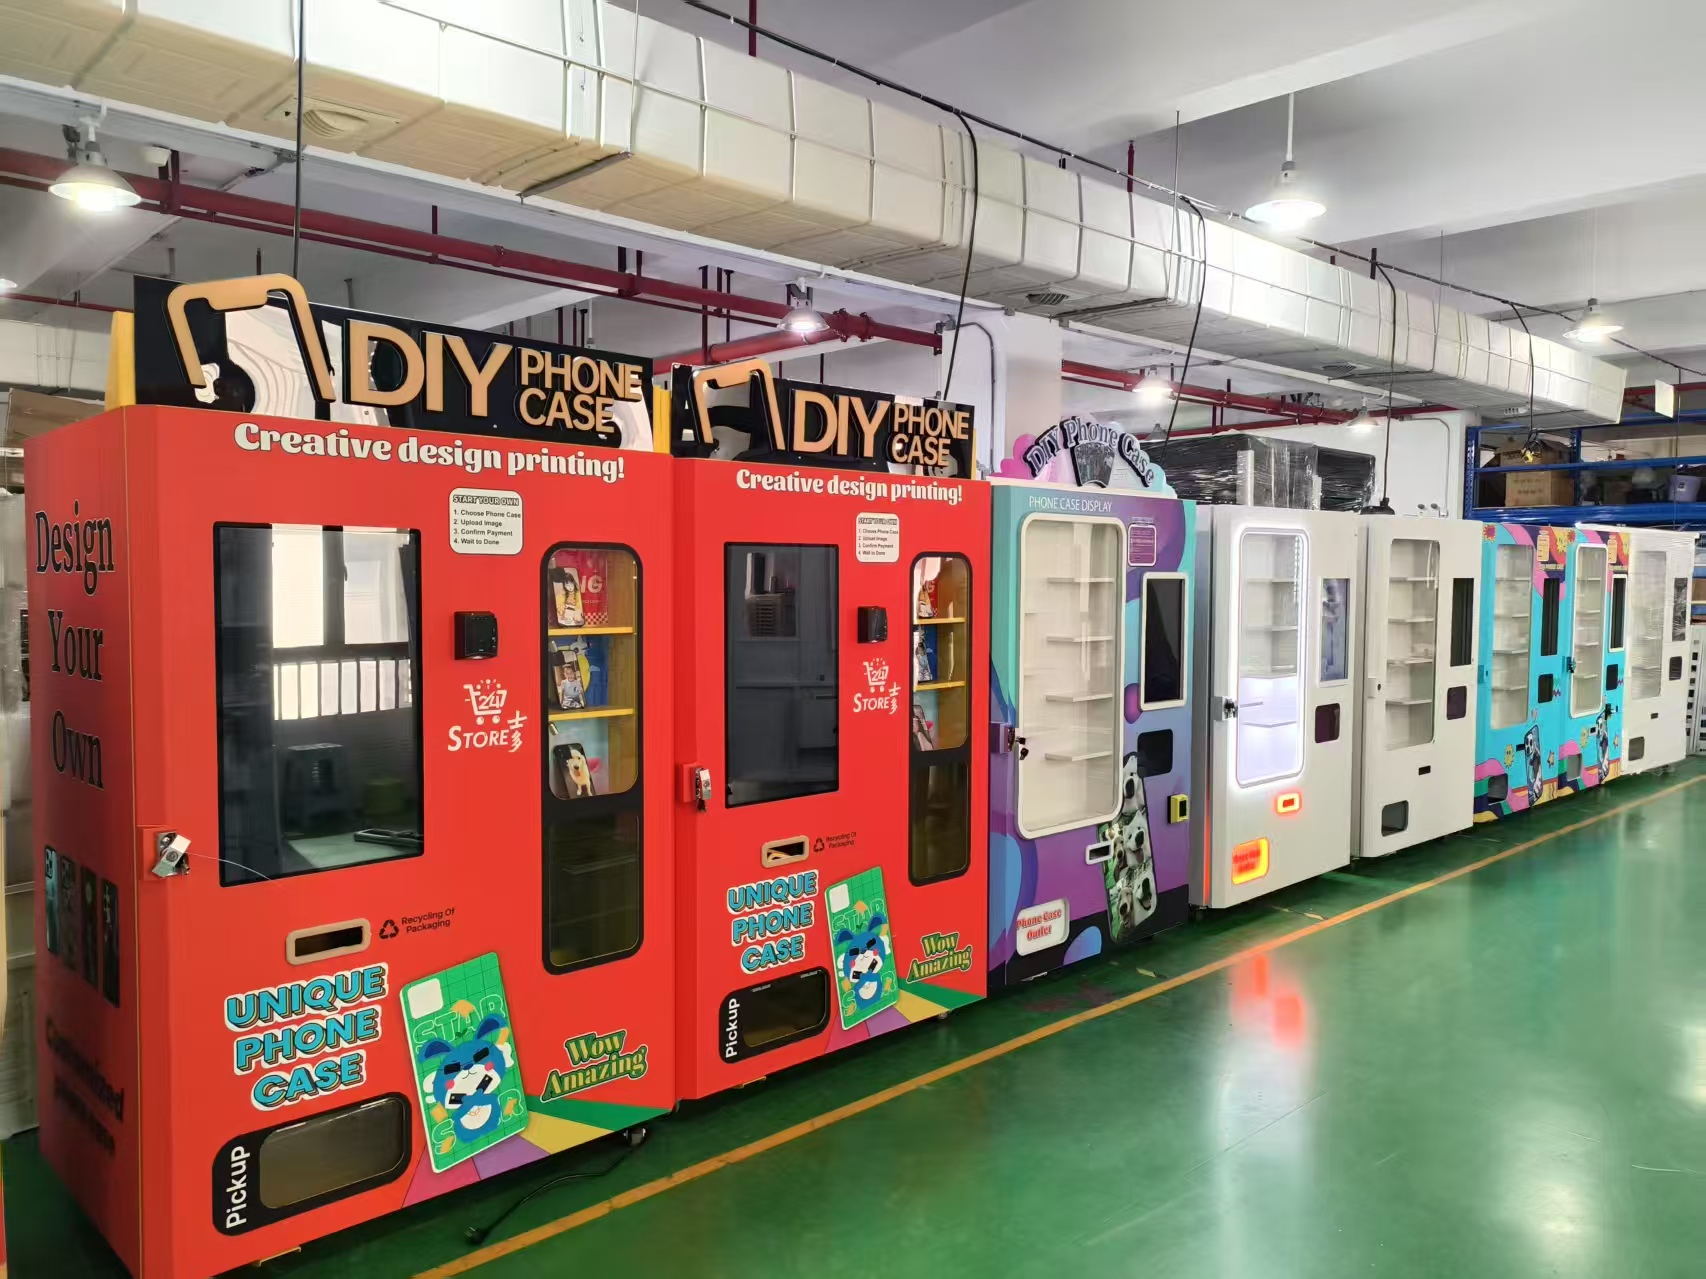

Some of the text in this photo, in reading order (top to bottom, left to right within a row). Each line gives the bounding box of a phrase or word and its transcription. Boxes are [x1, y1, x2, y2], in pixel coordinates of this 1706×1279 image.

[348, 320, 513, 417] DIY
[520, 346, 643, 402] PHONE
[518, 386, 616, 433] CASE
[793, 388, 891, 459] DIY
[893, 403, 970, 440] PHONE
[234, 422, 626, 484] Creative design printing!
[891, 433, 951, 467] CASE
[1027, 417, 1155, 484] DIY Phone Case
[453, 495, 519, 506] START YOUR OWN
[736, 468, 963, 506] Creative design printing!
[1029, 495, 1113, 513] PHONE CASE DISPLAY
[460, 509, 484, 517] Choose
[485, 510, 505, 518] Phone
[460, 519, 483, 527] Upload
[483, 520, 503, 528] Image
[460, 528, 486, 536] Confirm
[35, 499, 115, 597] Design
[47, 608, 104, 682] Your
[52, 709, 104, 790] Own
[728, 871, 818, 913] UNIQUE
[401, 907, 456, 925] Recycling Of
[406, 919, 451, 934] Packaging
[733, 902, 813, 944] PHONE
[1016, 909, 1062, 930] Phone Case
[742, 934, 804, 973] CASE
[907, 945, 972, 982] Amazing
[922, 933, 958, 957] Wow
[227, 965, 386, 1028] UNIQUE
[236, 1007, 380, 1072] PHONE
[566, 1031, 626, 1064] Wow
[725, 998, 740, 1058] Pickup
[252, 1052, 364, 1108] CASE
[543, 1046, 647, 1100] Amazing
[225, 1146, 250, 1229] Pickup
